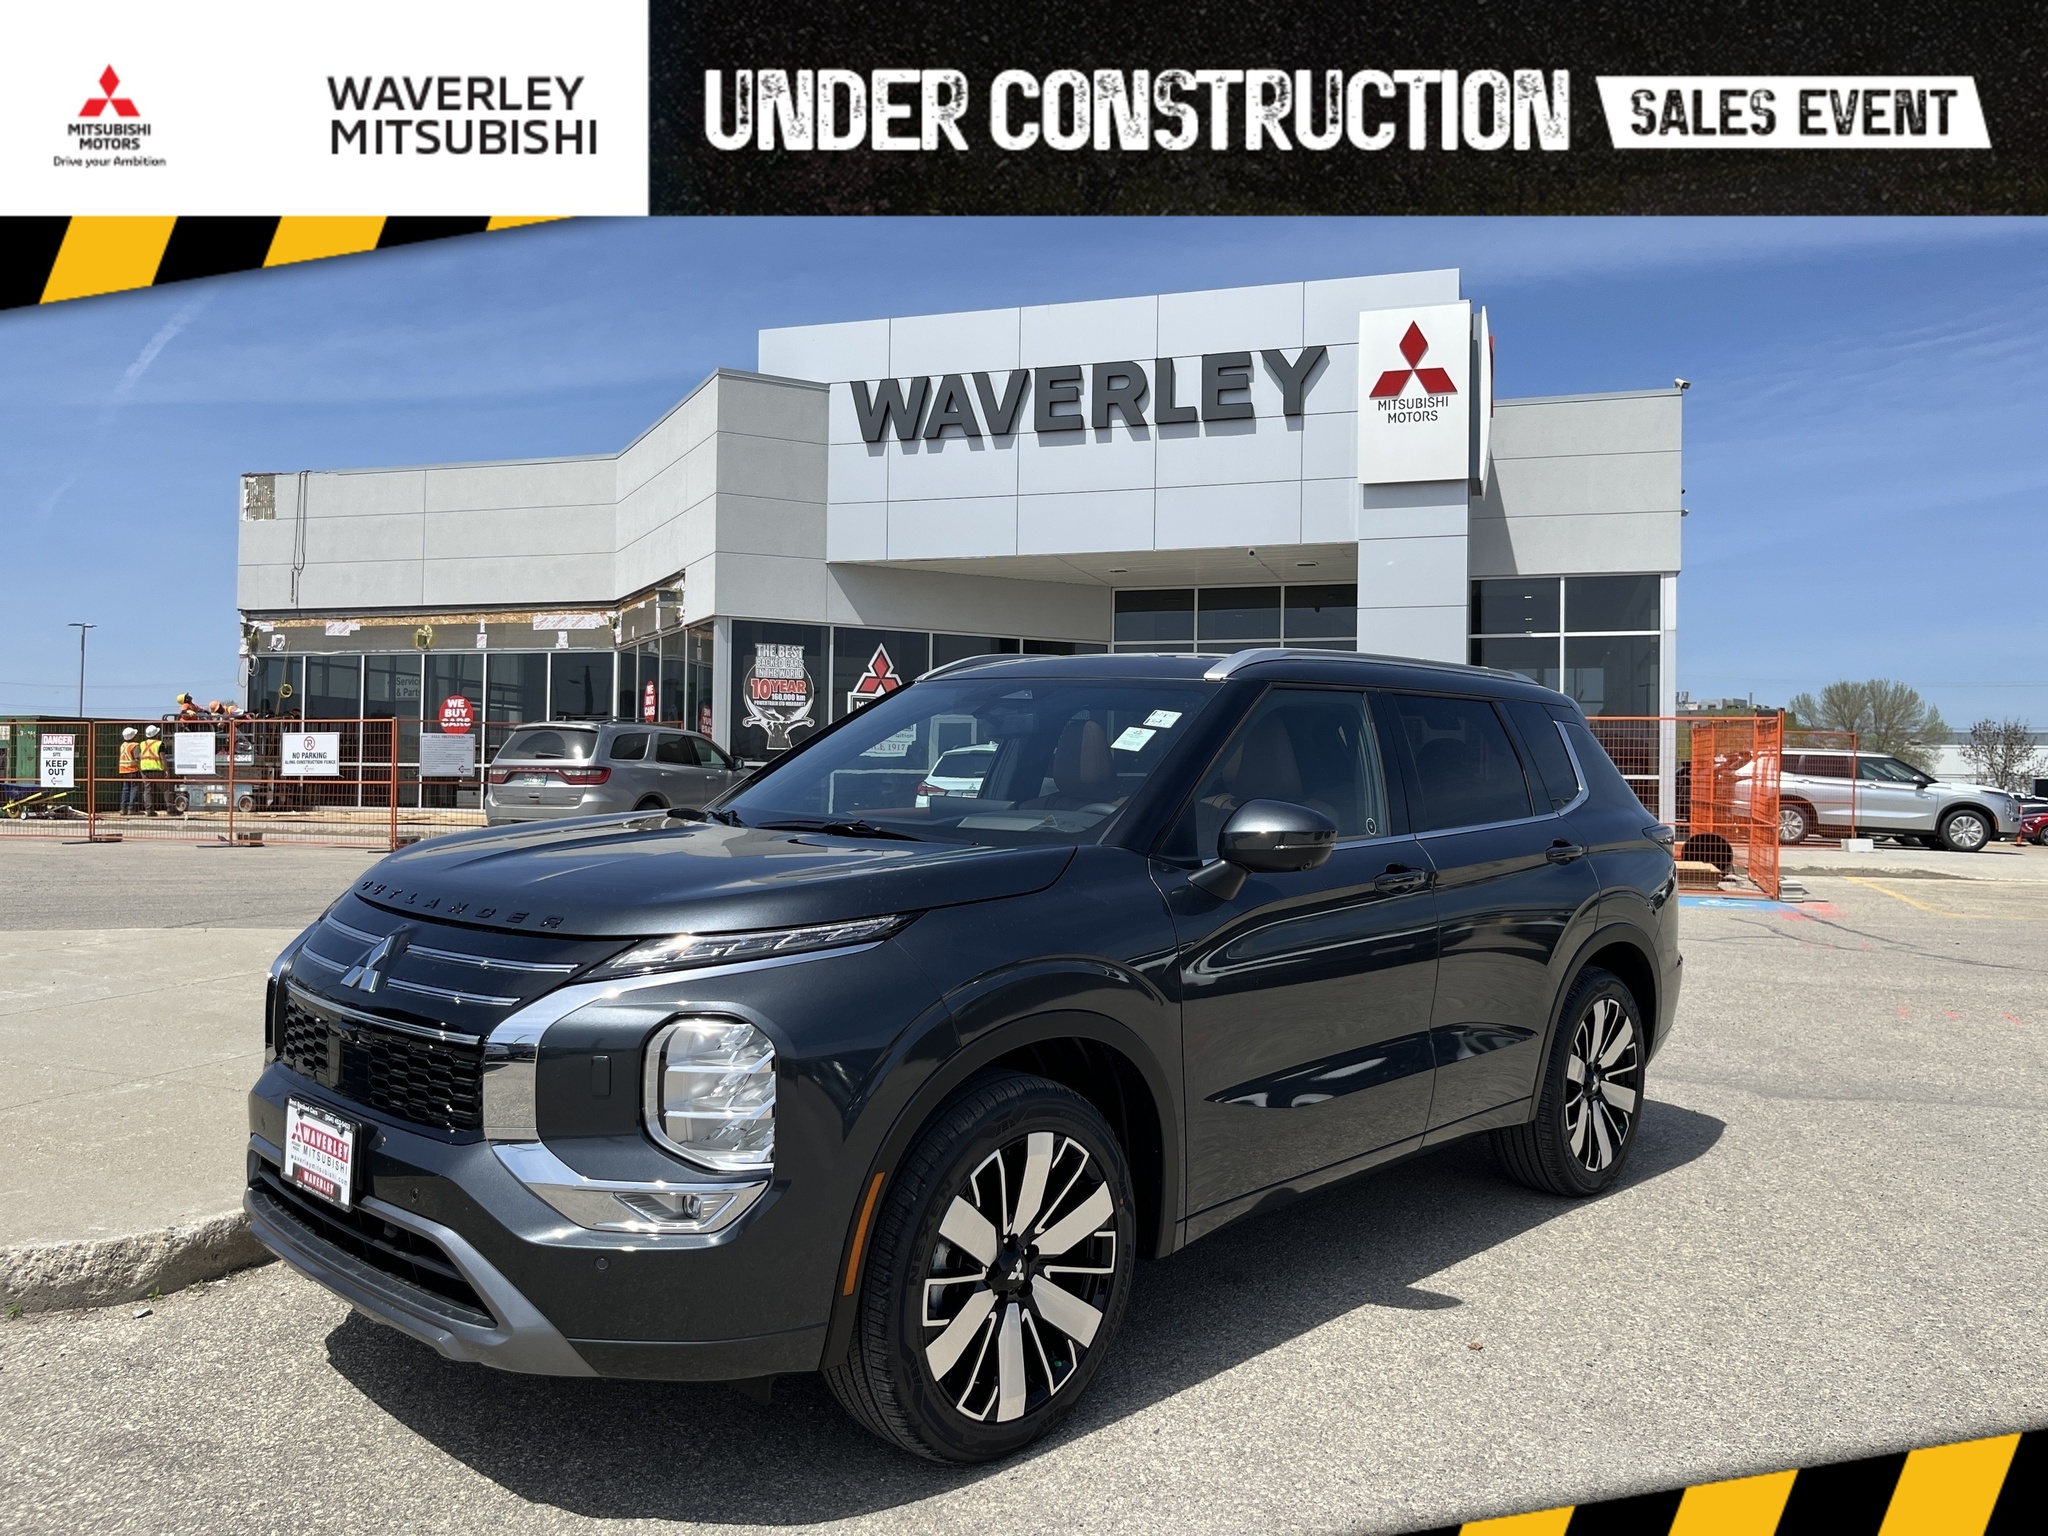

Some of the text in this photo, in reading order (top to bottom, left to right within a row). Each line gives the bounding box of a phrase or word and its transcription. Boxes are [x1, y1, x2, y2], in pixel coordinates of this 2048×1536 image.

[850, 345, 1328, 443] WAVERLEY
[1378, 396, 1449, 411] MITSUBISHI
[1387, 410, 1438, 424] MOTORS
[756, 644, 805, 659] THE BEST
[757, 659, 805, 668] BACKED CARS
[765, 668, 778, 678] THE
[779, 668, 804, 679] WORLD
[396, 677, 420, 686] Servic
[751, 678, 807, 700] 10 YEAR
[447, 699, 465, 708] WE
[444, 709, 468, 718] BUY
[441, 718, 471, 727] CARS
[43, 735, 73, 745] DANGER
[888, 743, 905, 751] 1917
[292, 751, 327, 759] NO PARKING
[46, 759, 68, 768] KEEP
[48, 768, 65, 776] OUT
[360, 880, 565, 929] OUTLANDER
[302, 1125, 349, 1161] WAVERLEY
[302, 1145, 348, 1175] MITSUBISHI
[303, 1169, 335, 1196] WAVERLEY
